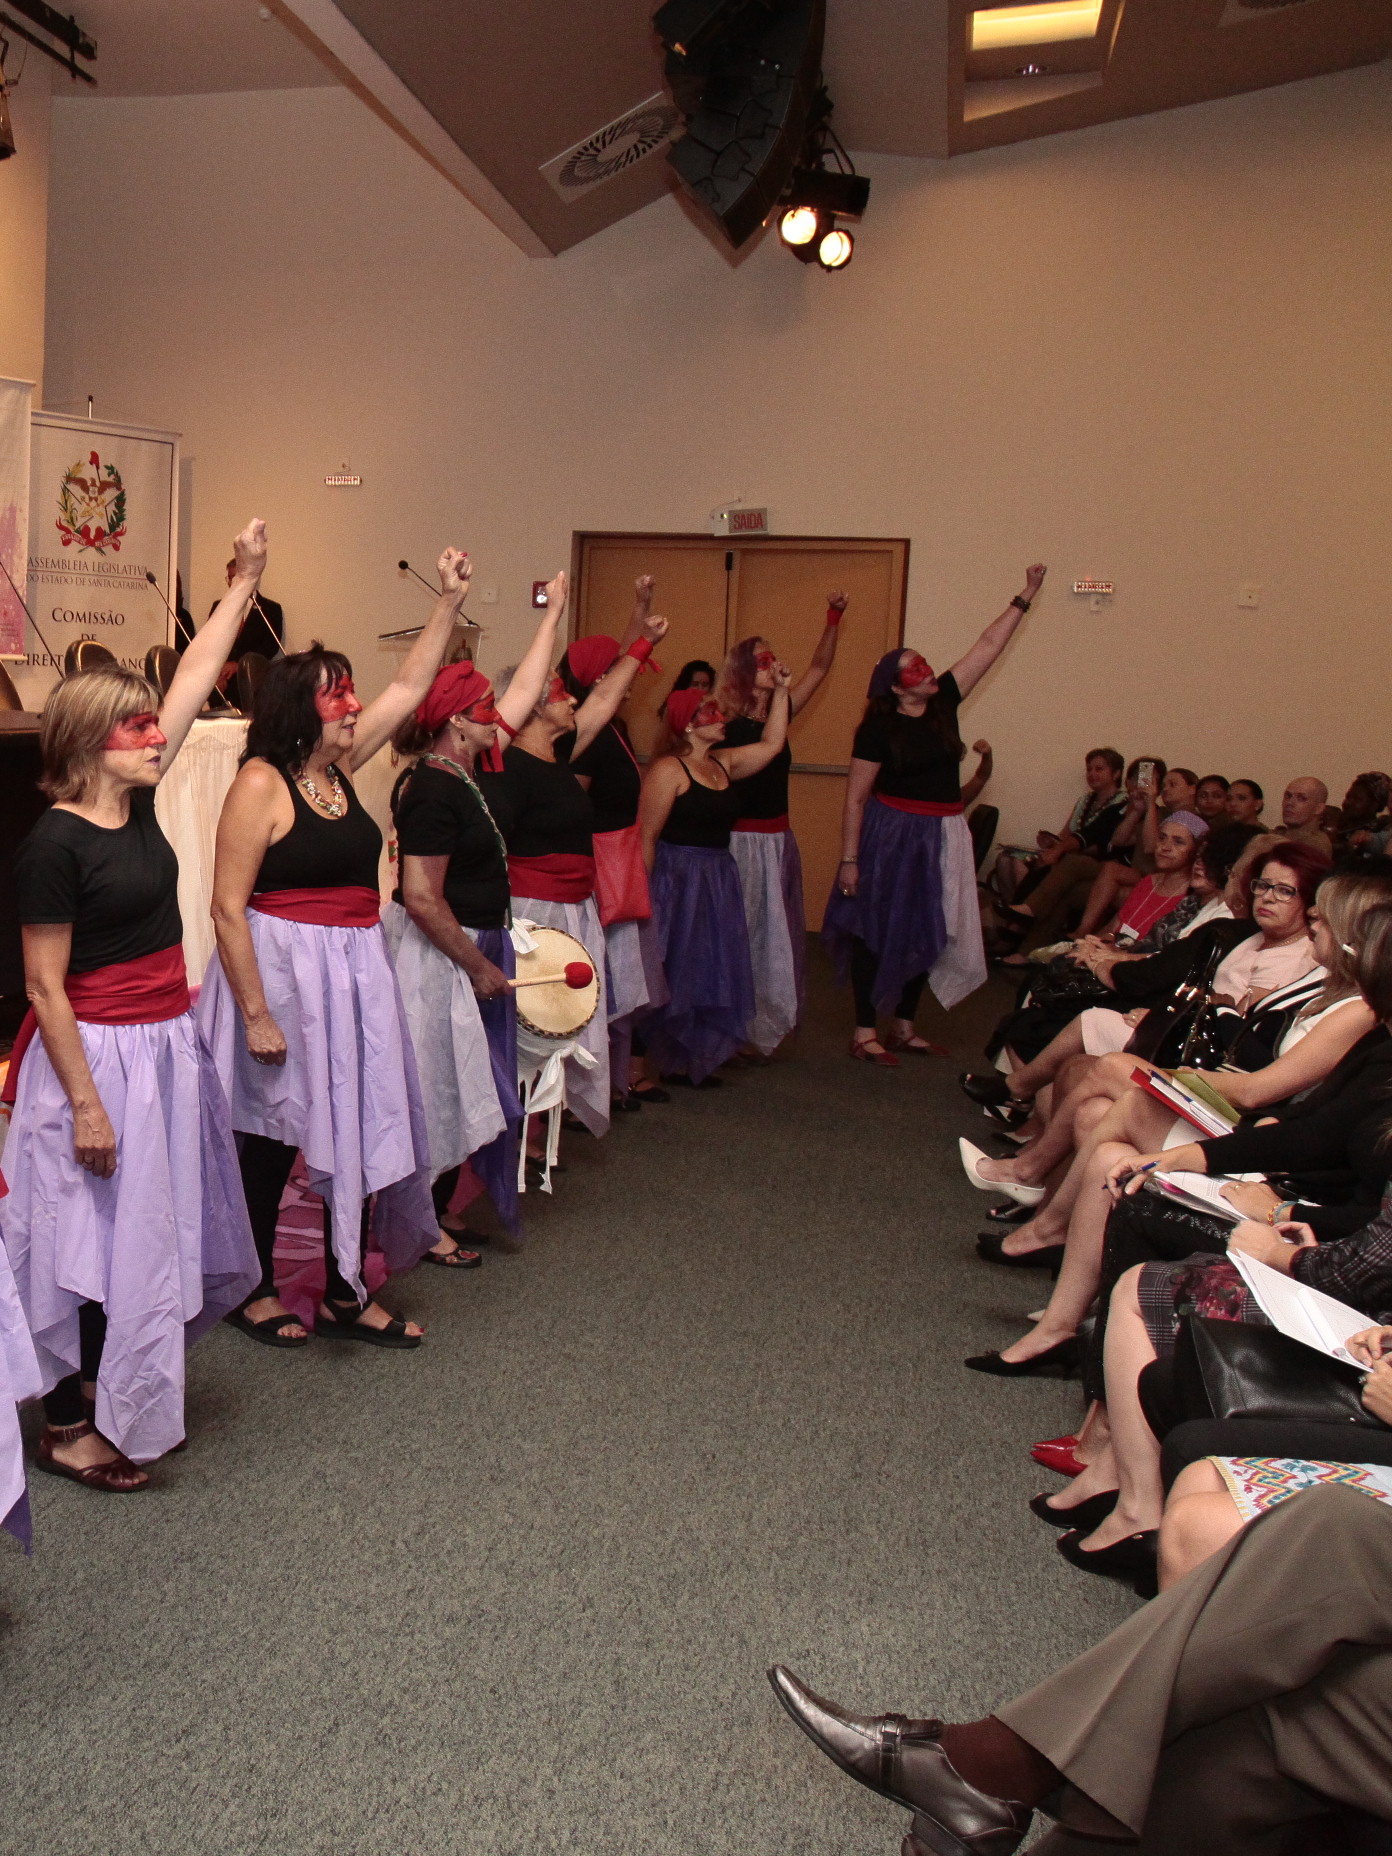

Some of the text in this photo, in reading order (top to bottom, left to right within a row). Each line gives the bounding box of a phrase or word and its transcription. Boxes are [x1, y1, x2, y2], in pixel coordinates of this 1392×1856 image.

[27, 556, 148, 577] ASSEMBLEIA LEGISLATIVA
[41, 574, 74, 585] ESTADO
[75, 576, 86, 586] DE
[87, 578, 112, 589] SANTA
[112, 579, 149, 591] CATARINA
[51, 607, 125, 626] COMISSÃO
